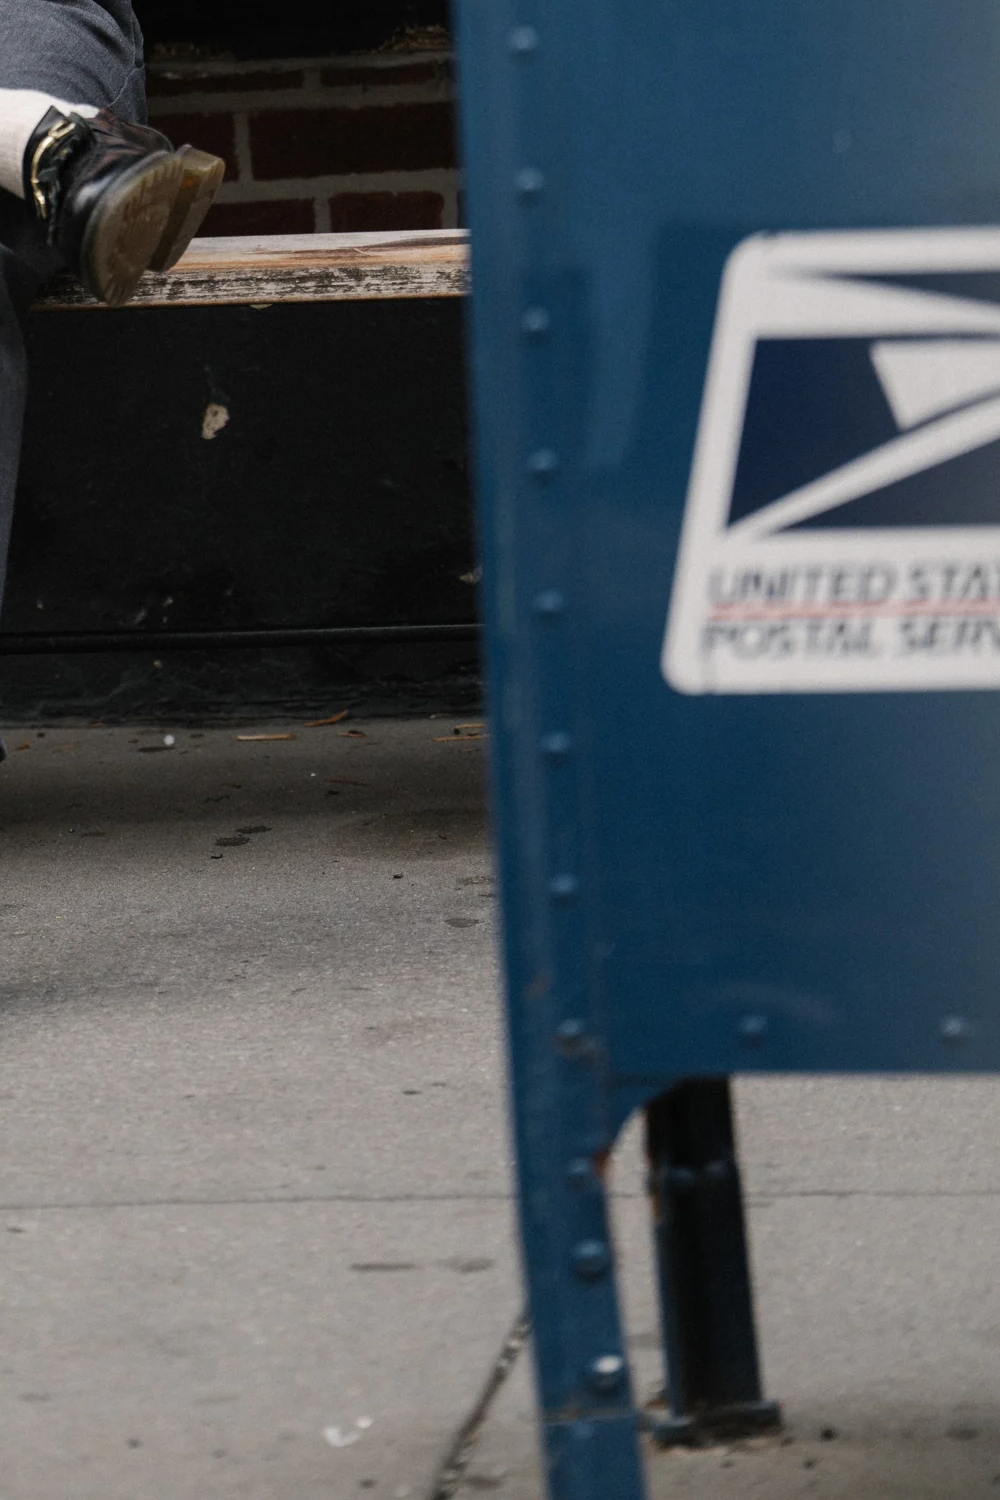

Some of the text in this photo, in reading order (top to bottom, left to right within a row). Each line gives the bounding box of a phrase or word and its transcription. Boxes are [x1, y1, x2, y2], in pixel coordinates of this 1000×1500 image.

[706, 558, 1000, 607] UNITED STA
[700, 616, 876, 660] POSTAL
